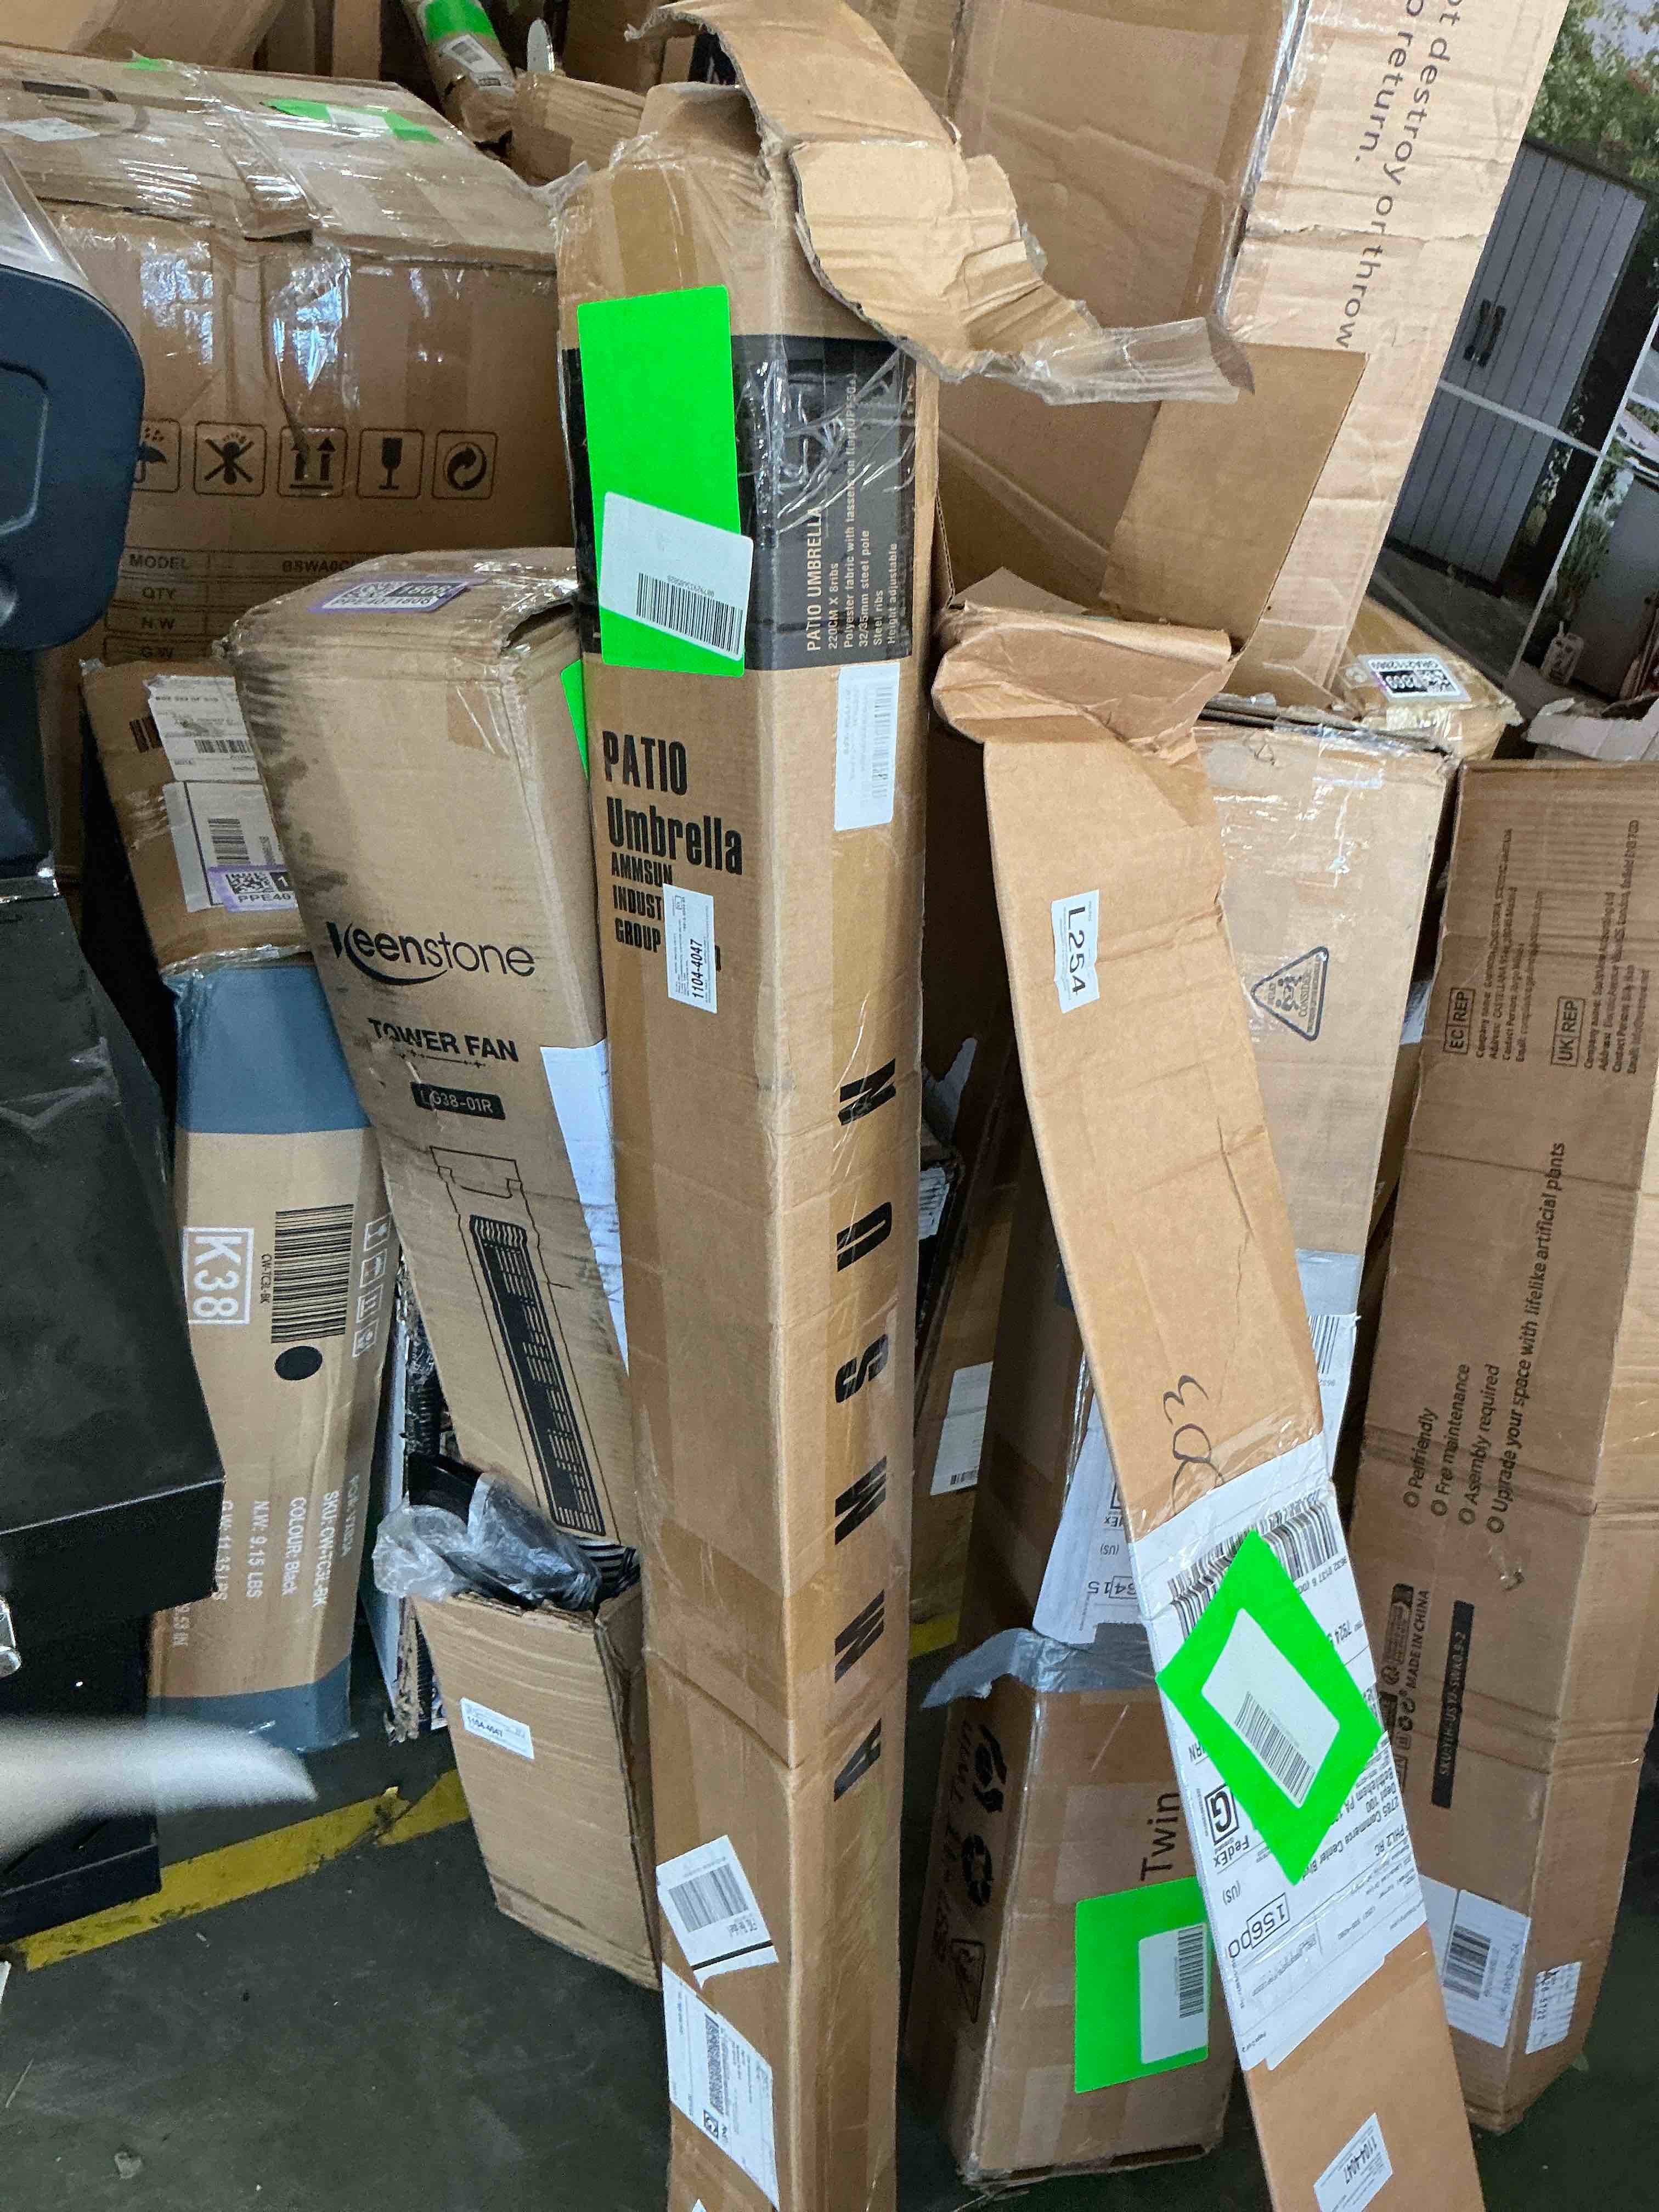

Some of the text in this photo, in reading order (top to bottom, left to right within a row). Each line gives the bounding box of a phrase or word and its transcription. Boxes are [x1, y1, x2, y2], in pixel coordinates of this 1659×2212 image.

[1355, 31, 1414, 163] return.
[1384, 38, 1451, 186] destroy
[1370, 196, 1393, 235] or
[1336, 245, 1383, 349] throw
[128, 554, 189, 571] MODEL
[845, 527, 855, 557] with
[142, 585, 176, 601] QTY
[808, 507, 822, 651] PATIO UMBRELLA
[830, 563, 839, 592] 8ribs
[845, 558, 854, 591] fabric
[859, 531, 871, 647] 32/35mm steel pole
[888, 544, 898, 645] Height adjustable
[829, 612, 838, 650] 220CM
[844, 594, 855, 648] Polyester
[873, 590, 883, 646] Steel ribs
[603, 731, 687, 795] PATIO
[607, 797, 742, 875] Umbrella
[611, 852, 673, 885] AMMSUN
[326, 921, 535, 985] Keenstone
[614, 918, 661, 952] GROUP
[692, 939, 704, 999] 1104-4047
[367, 1018, 518, 1062] TOWER FAN
[1450, 990, 1469, 1049] EC REP
[1558, 1000, 1579, 1061] UK REP
[193, 1237, 242, 1318] K38
[1492, 1142, 1565, 1514] Upgrade your space with lifelike artificial plants
[1440, 1364, 1470, 1462] maintenance
[1480, 1364, 1500, 1430] required
[281, 1497, 307, 1596] COLOUR: Black
[246, 1571, 264, 1598] LBS
[1406, 1590, 1430, 1689] MADE IN CHINA
[1140, 1792, 1181, 1882] Twin
[1211, 1791, 1232, 1832] G
[1213, 1834, 1250, 1867] FedEx
[1222, 1880, 1242, 1905] (US)
